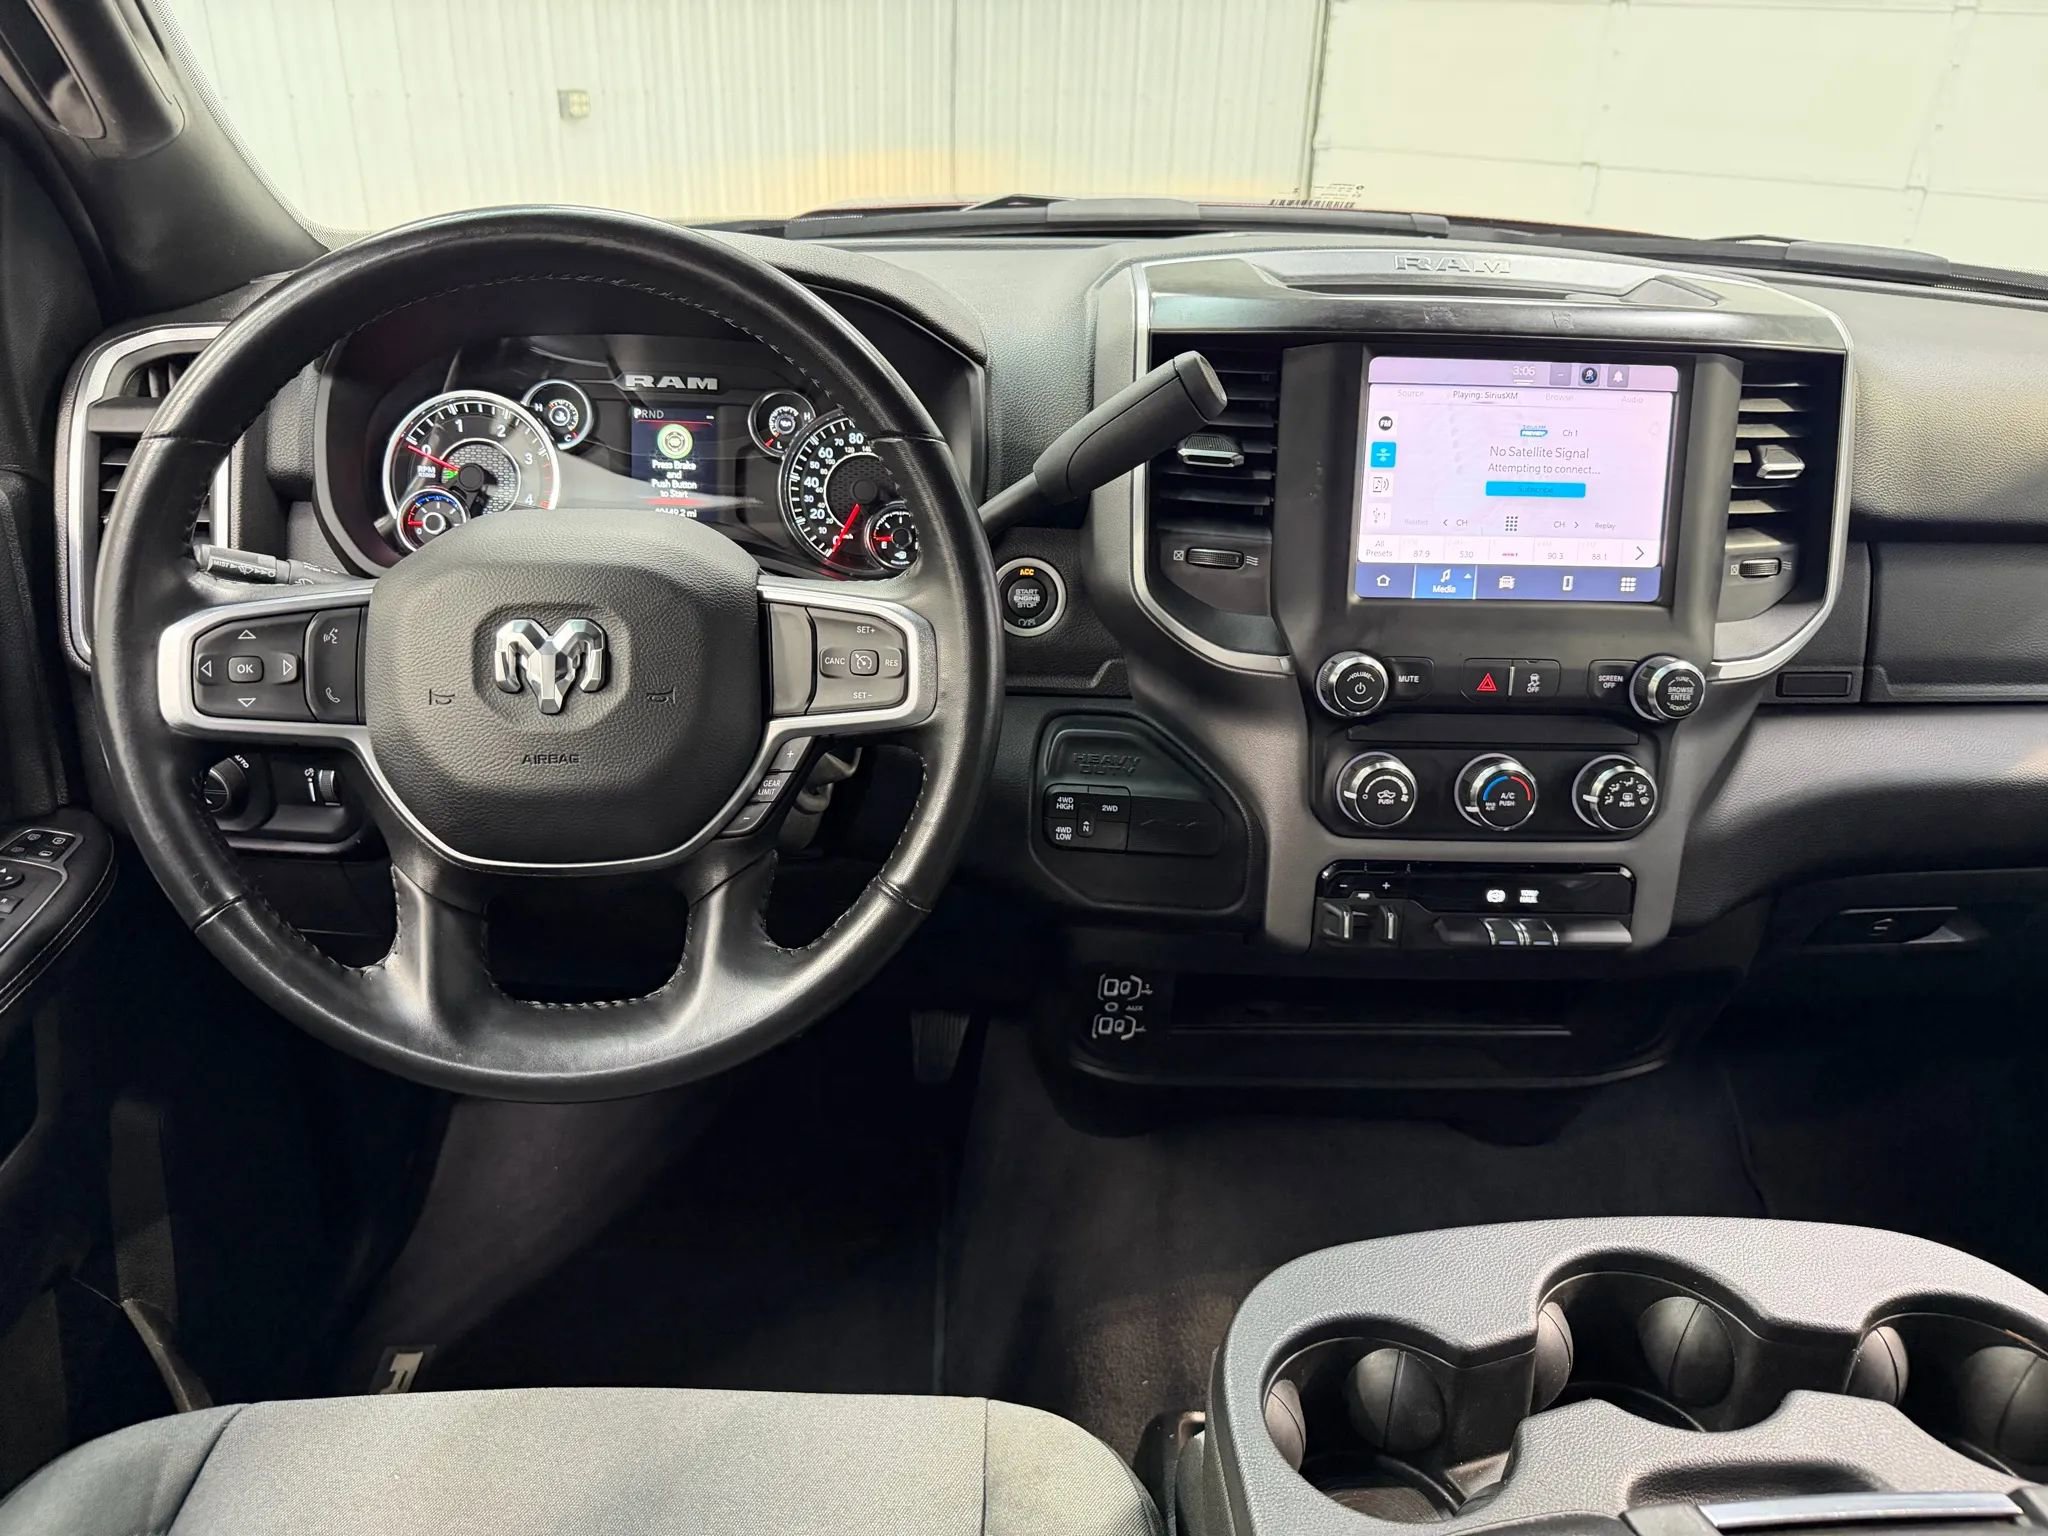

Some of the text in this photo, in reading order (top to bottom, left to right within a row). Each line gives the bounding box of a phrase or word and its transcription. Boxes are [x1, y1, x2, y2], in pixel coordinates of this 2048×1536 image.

[1395, 255, 1511, 273] RAM
[625, 375, 718, 390] RAM
[1453, 391, 1518, 400] Playing: SiriusXM
[633, 408, 664, 419] PRND
[803, 412, 811, 420] H
[455, 419, 463, 432] 1
[497, 425, 506, 437] 2
[1562, 429, 1573, 438] Ch
[834, 438, 844, 446] 70
[848, 433, 864, 444] 80
[818, 447, 833, 458] 60
[1489, 446, 1590, 461] No Satellite Signal
[524, 452, 533, 465] 3
[652, 460, 696, 470] Press Brake
[809, 461, 820, 469] 50
[1488, 463, 1601, 475] Attempting to connect...
[666, 471, 682, 479] and
[651, 479, 697, 489] Push Button
[804, 477, 819, 487] 40
[669, 489, 688, 498] Start
[525, 494, 534, 505] 4
[687, 509, 697, 518] mi
[809, 508, 825, 519] 20
[1366, 549, 1393, 557] Presets
[1019, 568, 1035, 576] ACC
[1432, 585, 1457, 593] Media
[824, 657, 846, 665] CANC
[884, 659, 899, 667] RES
[236, 664, 253, 674] OK
[1350, 671, 1372, 679] VOLUME
[1398, 675, 1420, 683] MUTE
[1669, 703, 1690, 711] SCROLL
[520, 754, 580, 765] AIRBAG
[1073, 752, 1142, 766] HEAVY
[1079, 764, 1137, 777] DUTY
[763, 779, 781, 787] GEAR
[757, 788, 776, 796] LIMIT
[1101, 804, 1118, 812] 2WD
